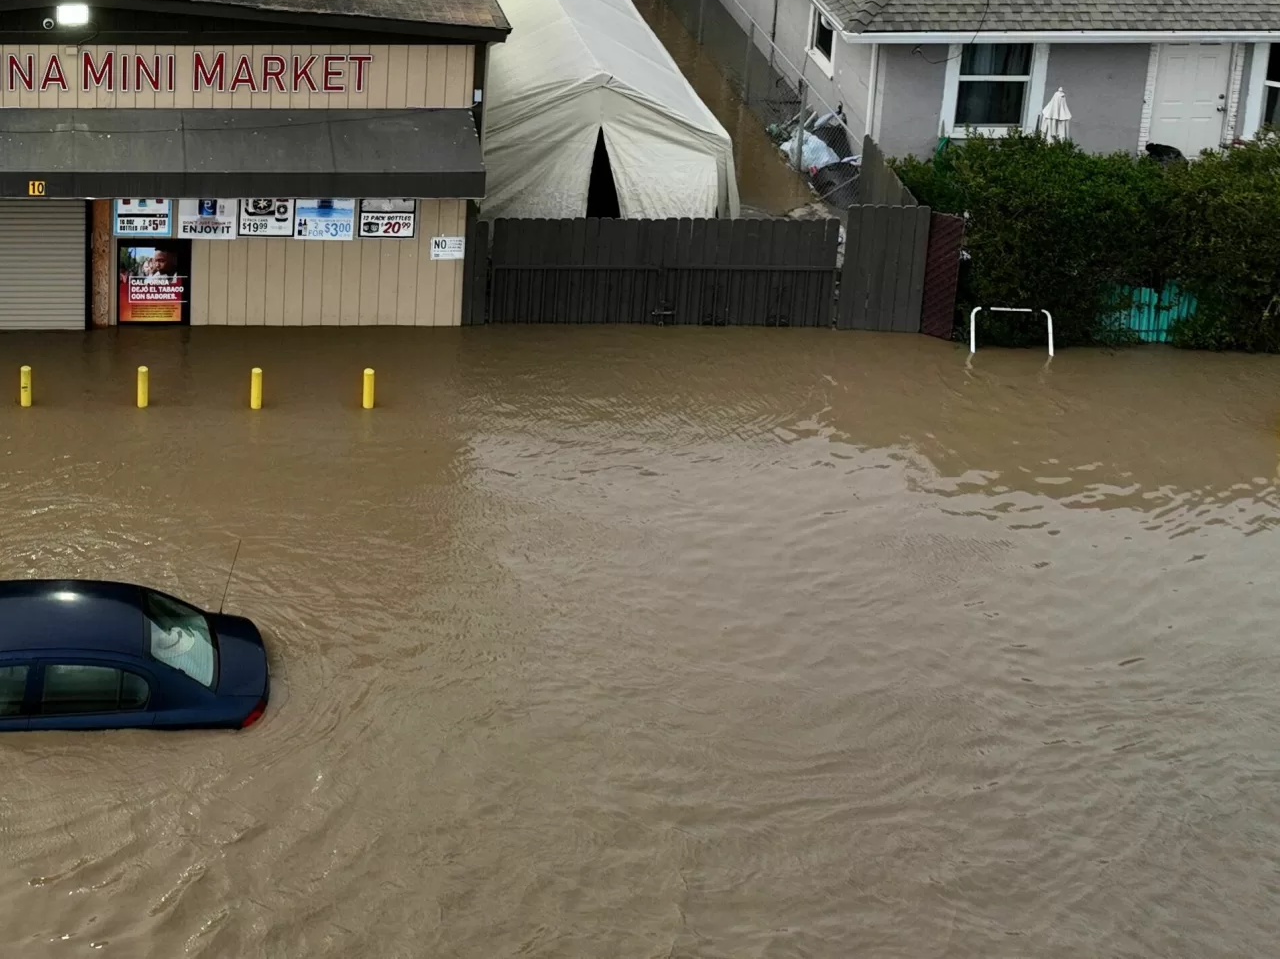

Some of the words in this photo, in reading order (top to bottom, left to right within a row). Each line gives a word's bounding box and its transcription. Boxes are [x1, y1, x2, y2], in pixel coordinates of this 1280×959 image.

[82, 50, 175, 92] MINI
[192, 51, 372, 92] MARKET
[30, 182, 44, 194] 10
[182, 225, 218, 234] ENJOY
[434, 240, 447, 249] NO
